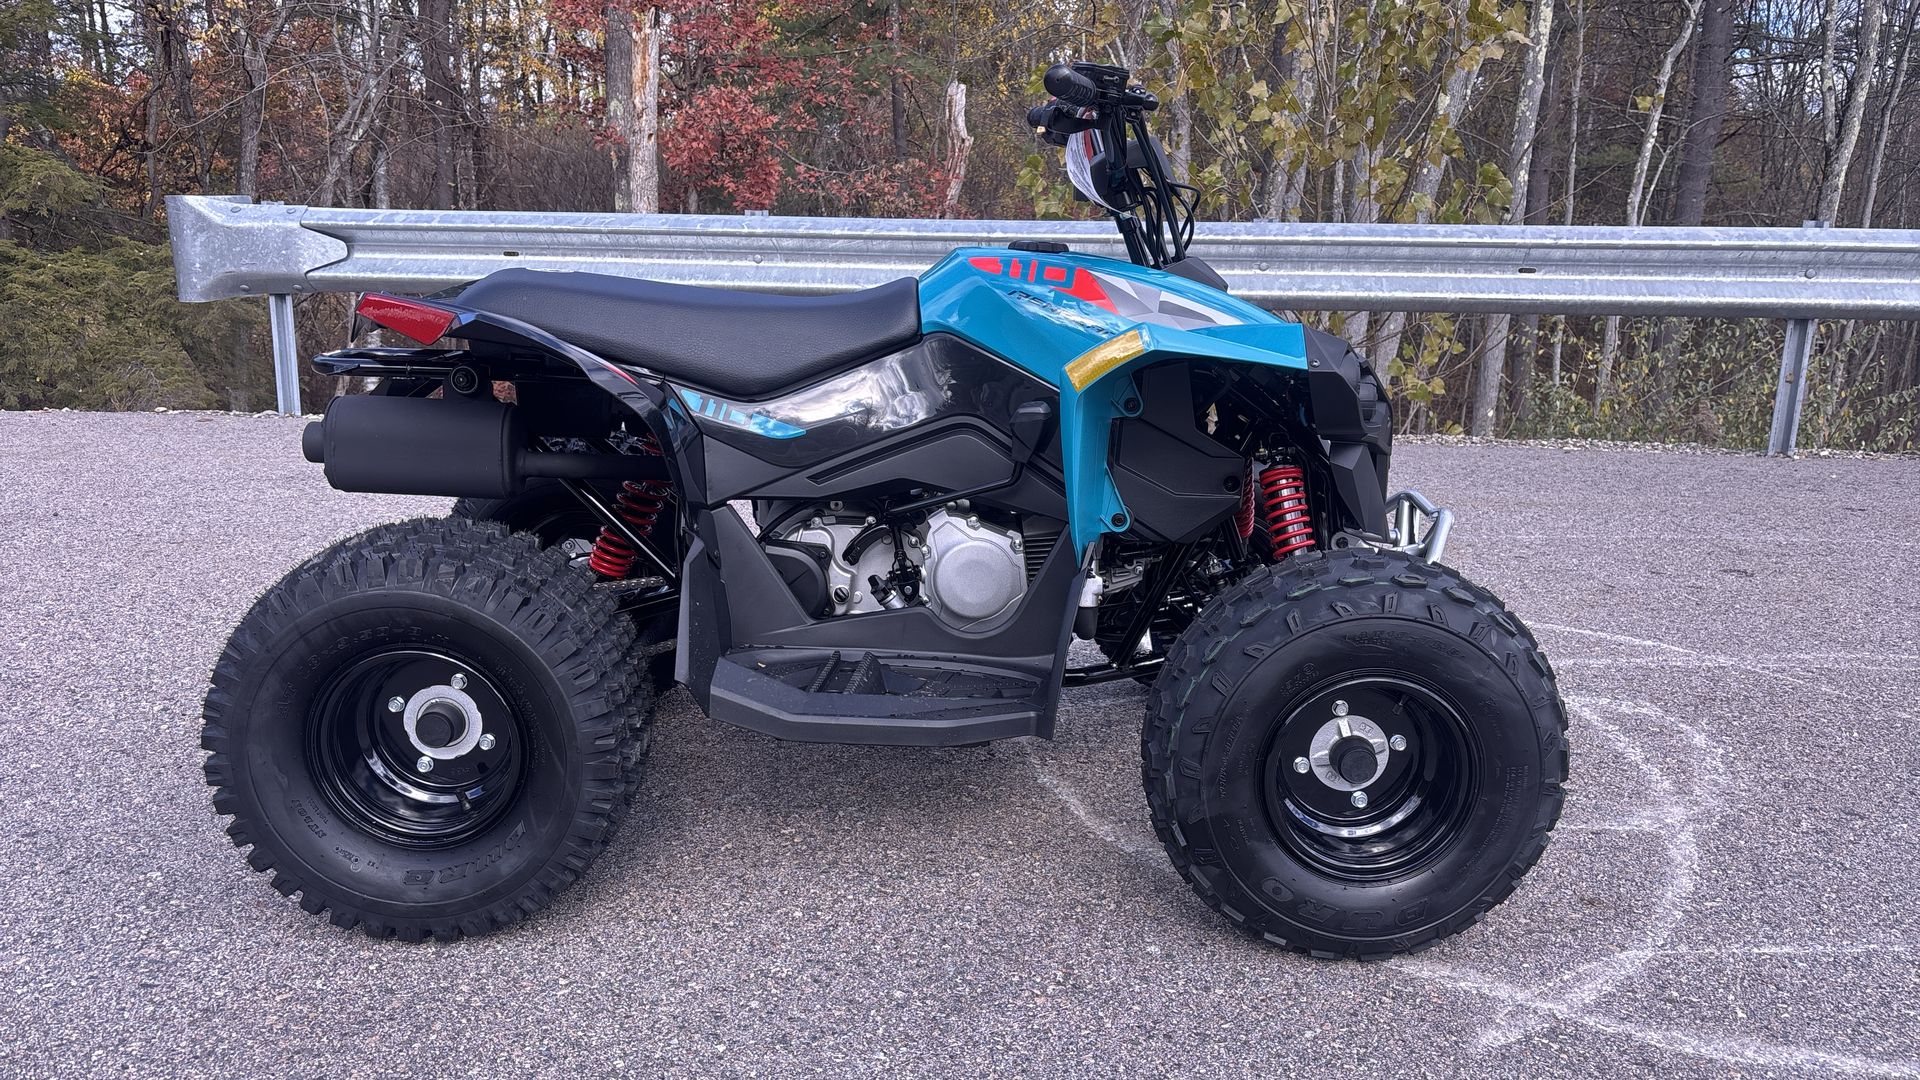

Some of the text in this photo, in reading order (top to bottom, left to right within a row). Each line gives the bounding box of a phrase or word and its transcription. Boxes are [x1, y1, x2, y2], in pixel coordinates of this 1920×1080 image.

[998, 258, 1075, 289] 110
[402, 818, 528, 887] DURO
[1261, 876, 1432, 930] DURO
